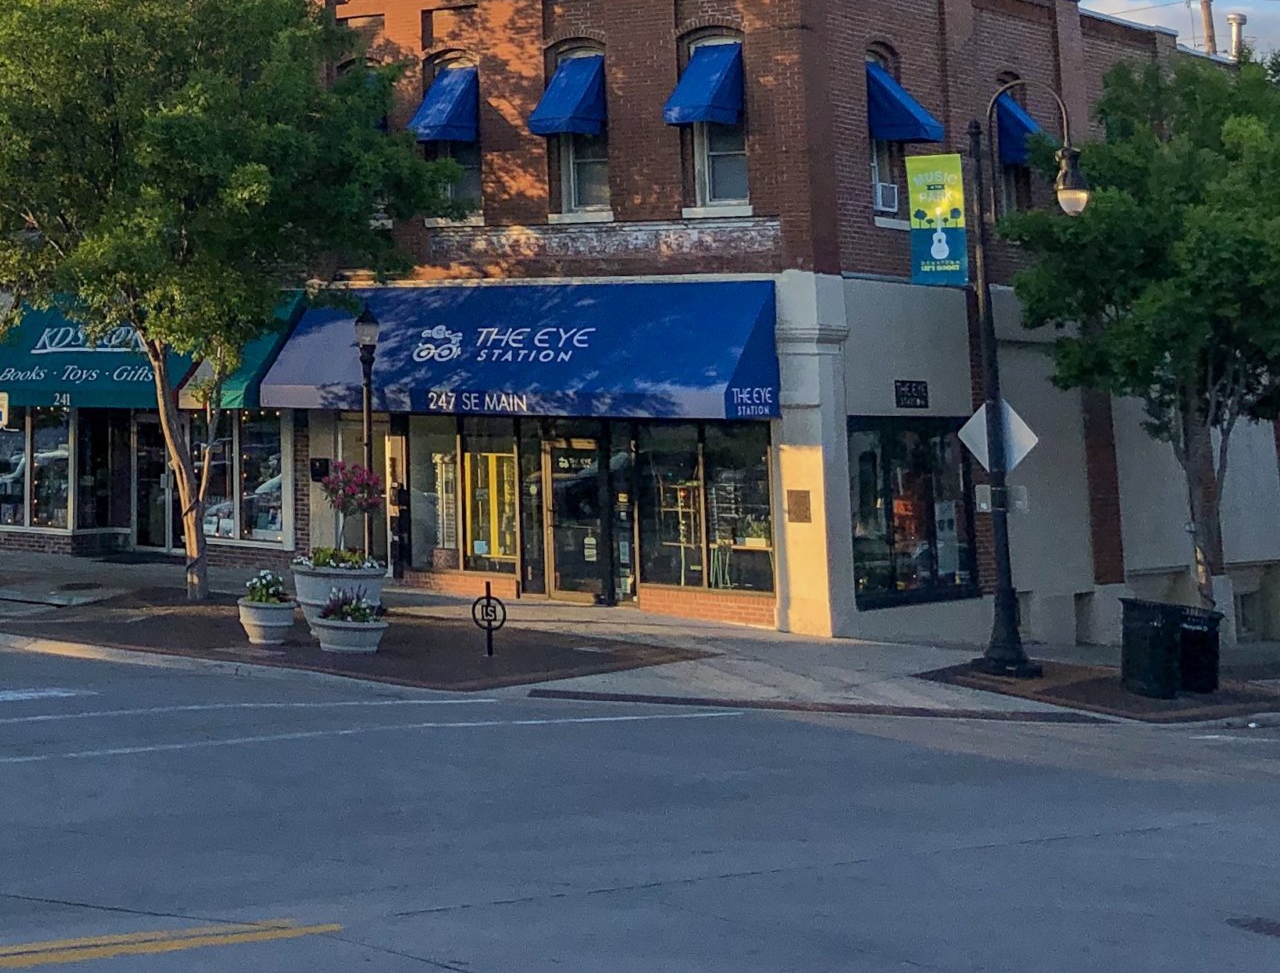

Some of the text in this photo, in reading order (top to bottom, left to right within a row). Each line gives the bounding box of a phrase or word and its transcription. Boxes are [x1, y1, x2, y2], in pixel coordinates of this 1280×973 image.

[913, 171, 958, 186] MUSIC
[919, 190, 953, 202] PARK
[476, 327, 596, 348] THE EYE
[476, 350, 573, 363] STATION
[61, 365, 100, 384] Toys
[113, 366, 155, 382] Gifts
[53, 392, 71, 406] 241
[428, 392, 528, 412] 247 SE MAIN
[732, 387, 773, 404] THE EYE
[737, 406, 770, 417] STATION
[483, 606, 496, 621] LS
